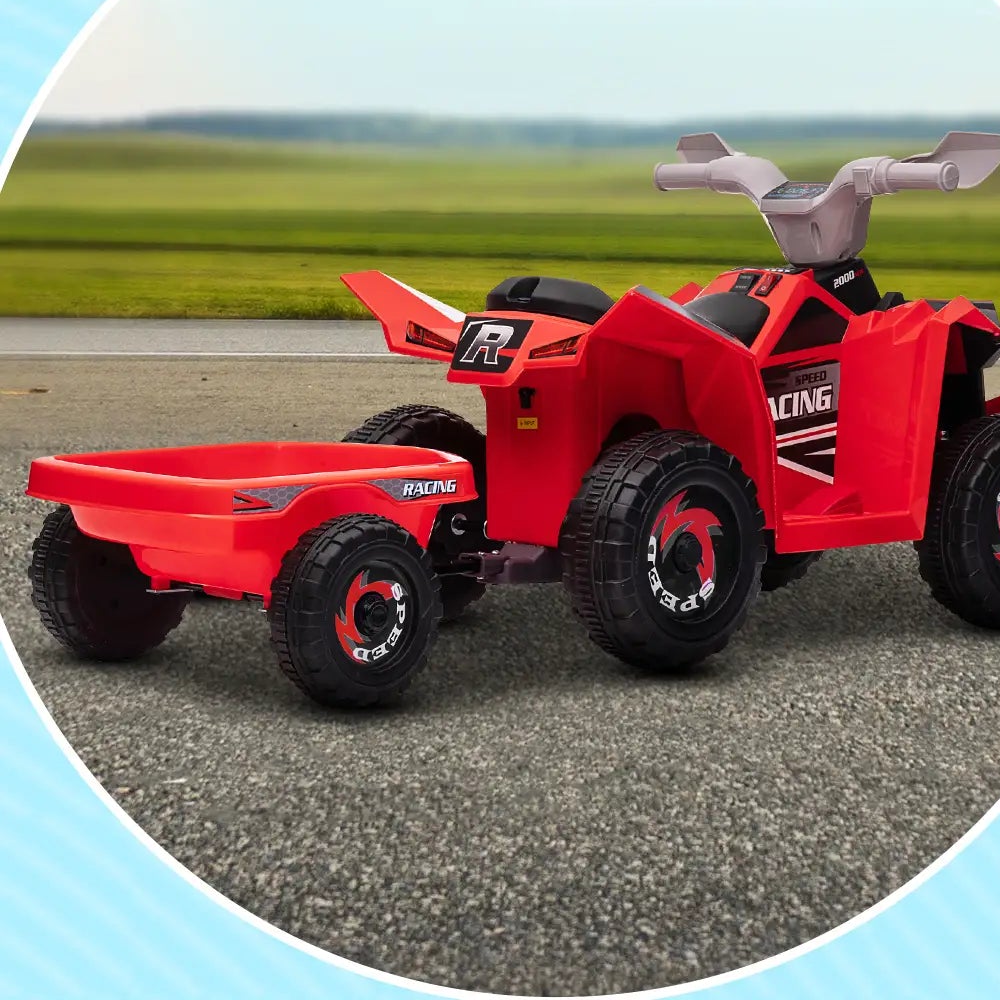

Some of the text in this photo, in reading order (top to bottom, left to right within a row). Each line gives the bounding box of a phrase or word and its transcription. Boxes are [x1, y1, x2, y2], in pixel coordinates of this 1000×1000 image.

[833, 269, 855, 289] 2000
[460, 324, 514, 366] R
[796, 371, 827, 385] SPEED
[403, 480, 457, 497] RACING
[646, 535, 715, 612] SPEED
[353, 582, 406, 661] SPEED
